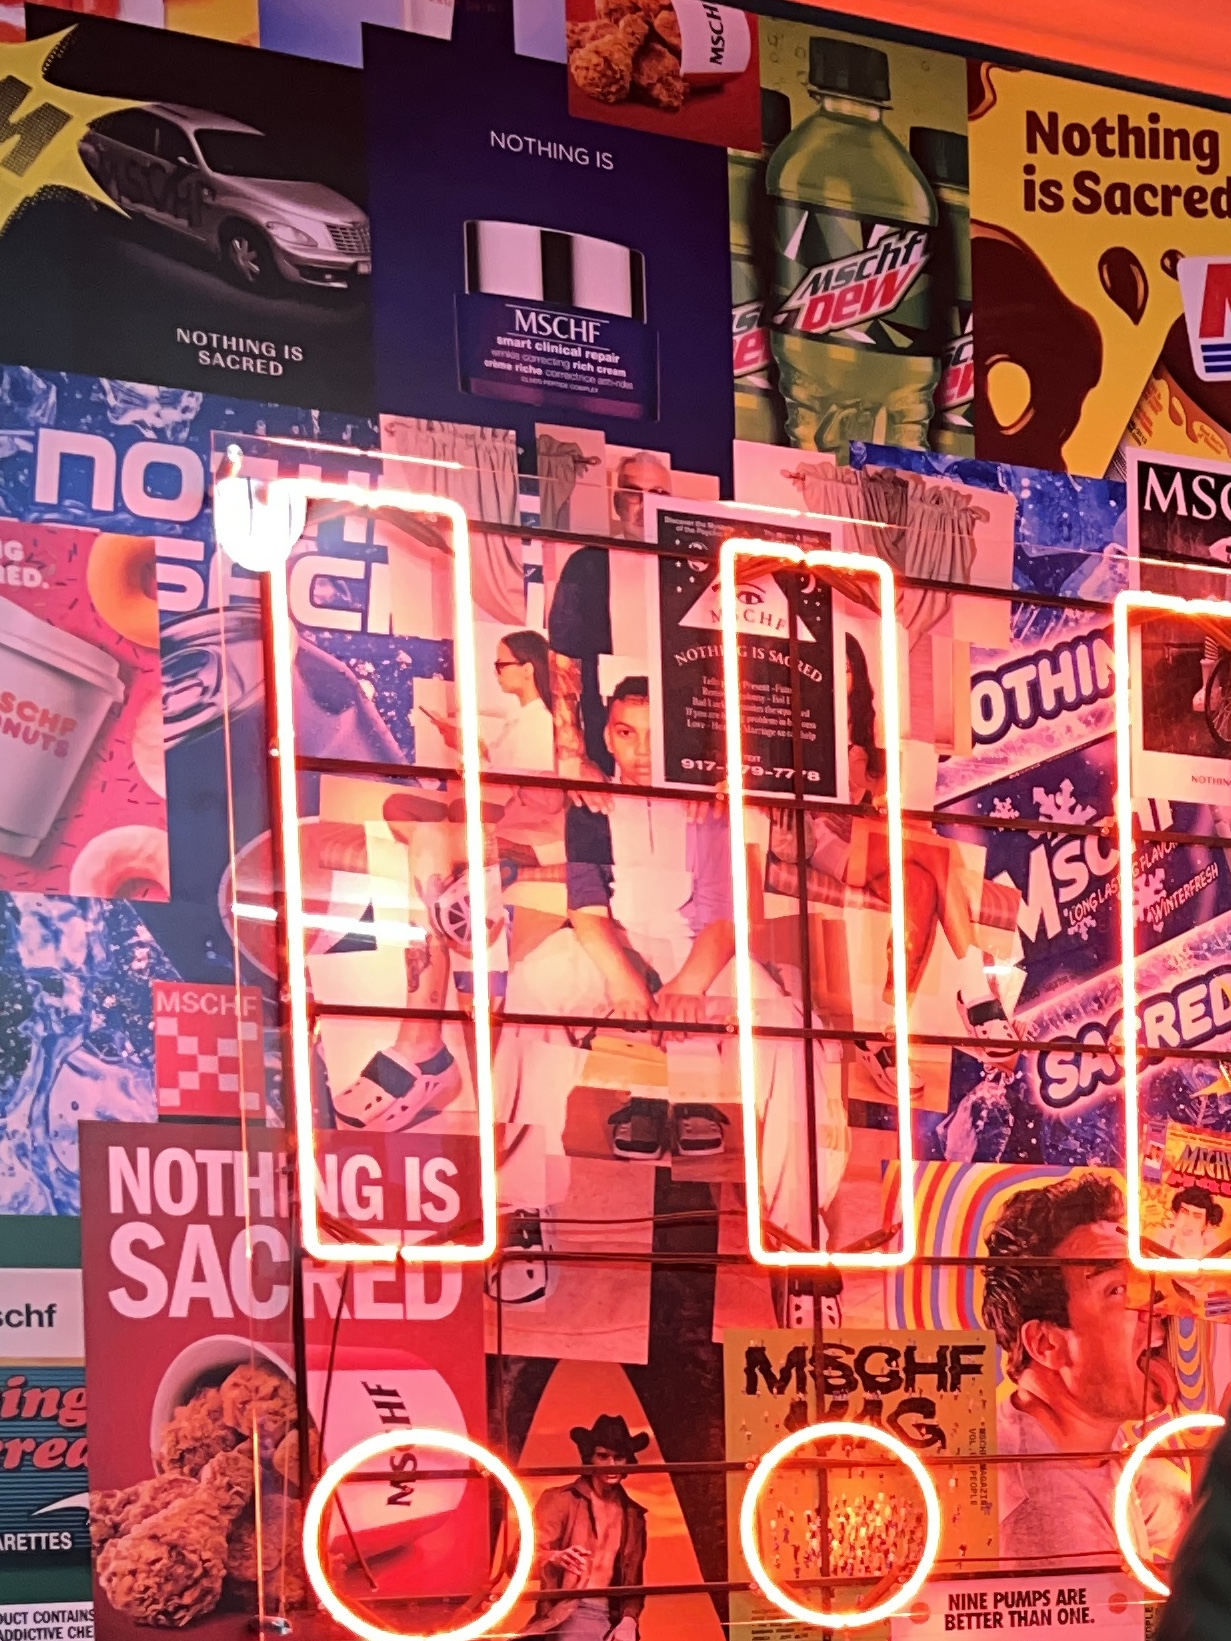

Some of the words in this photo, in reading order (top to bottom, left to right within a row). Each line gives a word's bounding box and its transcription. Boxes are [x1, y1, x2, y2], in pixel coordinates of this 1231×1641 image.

[490, 130, 590, 166] NOTHING
[595, 151, 615, 171] IS
[1025, 110, 1220, 175] Nothing
[1022, 164, 1064, 213] is
[514, 309, 602, 343] MSCHF
[176, 327, 277, 358] NOTHING
[283, 344, 304, 362] IS
[496, 336, 532, 350] smart
[535, 341, 582, 358] clinical
[585, 350, 621, 365] repair
[198, 350, 283, 376] SACRED
[710, 608, 787, 633] MCHF
[1149, 861, 1219, 924] WINTERFRESH
[157, 991, 258, 1017] MSCHF
[405, 1155, 462, 1225] IS
[744, 1342, 987, 1396] MSCHF
[361, 1381, 419, 1507] MSHF
[948, 1592, 988, 1612] NINE
[993, 1590, 1051, 1610] PUMPS
[1055, 1587, 1088, 1608] ARE
[944, 1610, 1007, 1632] BETTER
[1009, 1608, 1053, 1629] THAN
[1057, 1606, 1096, 1626] ONE.
